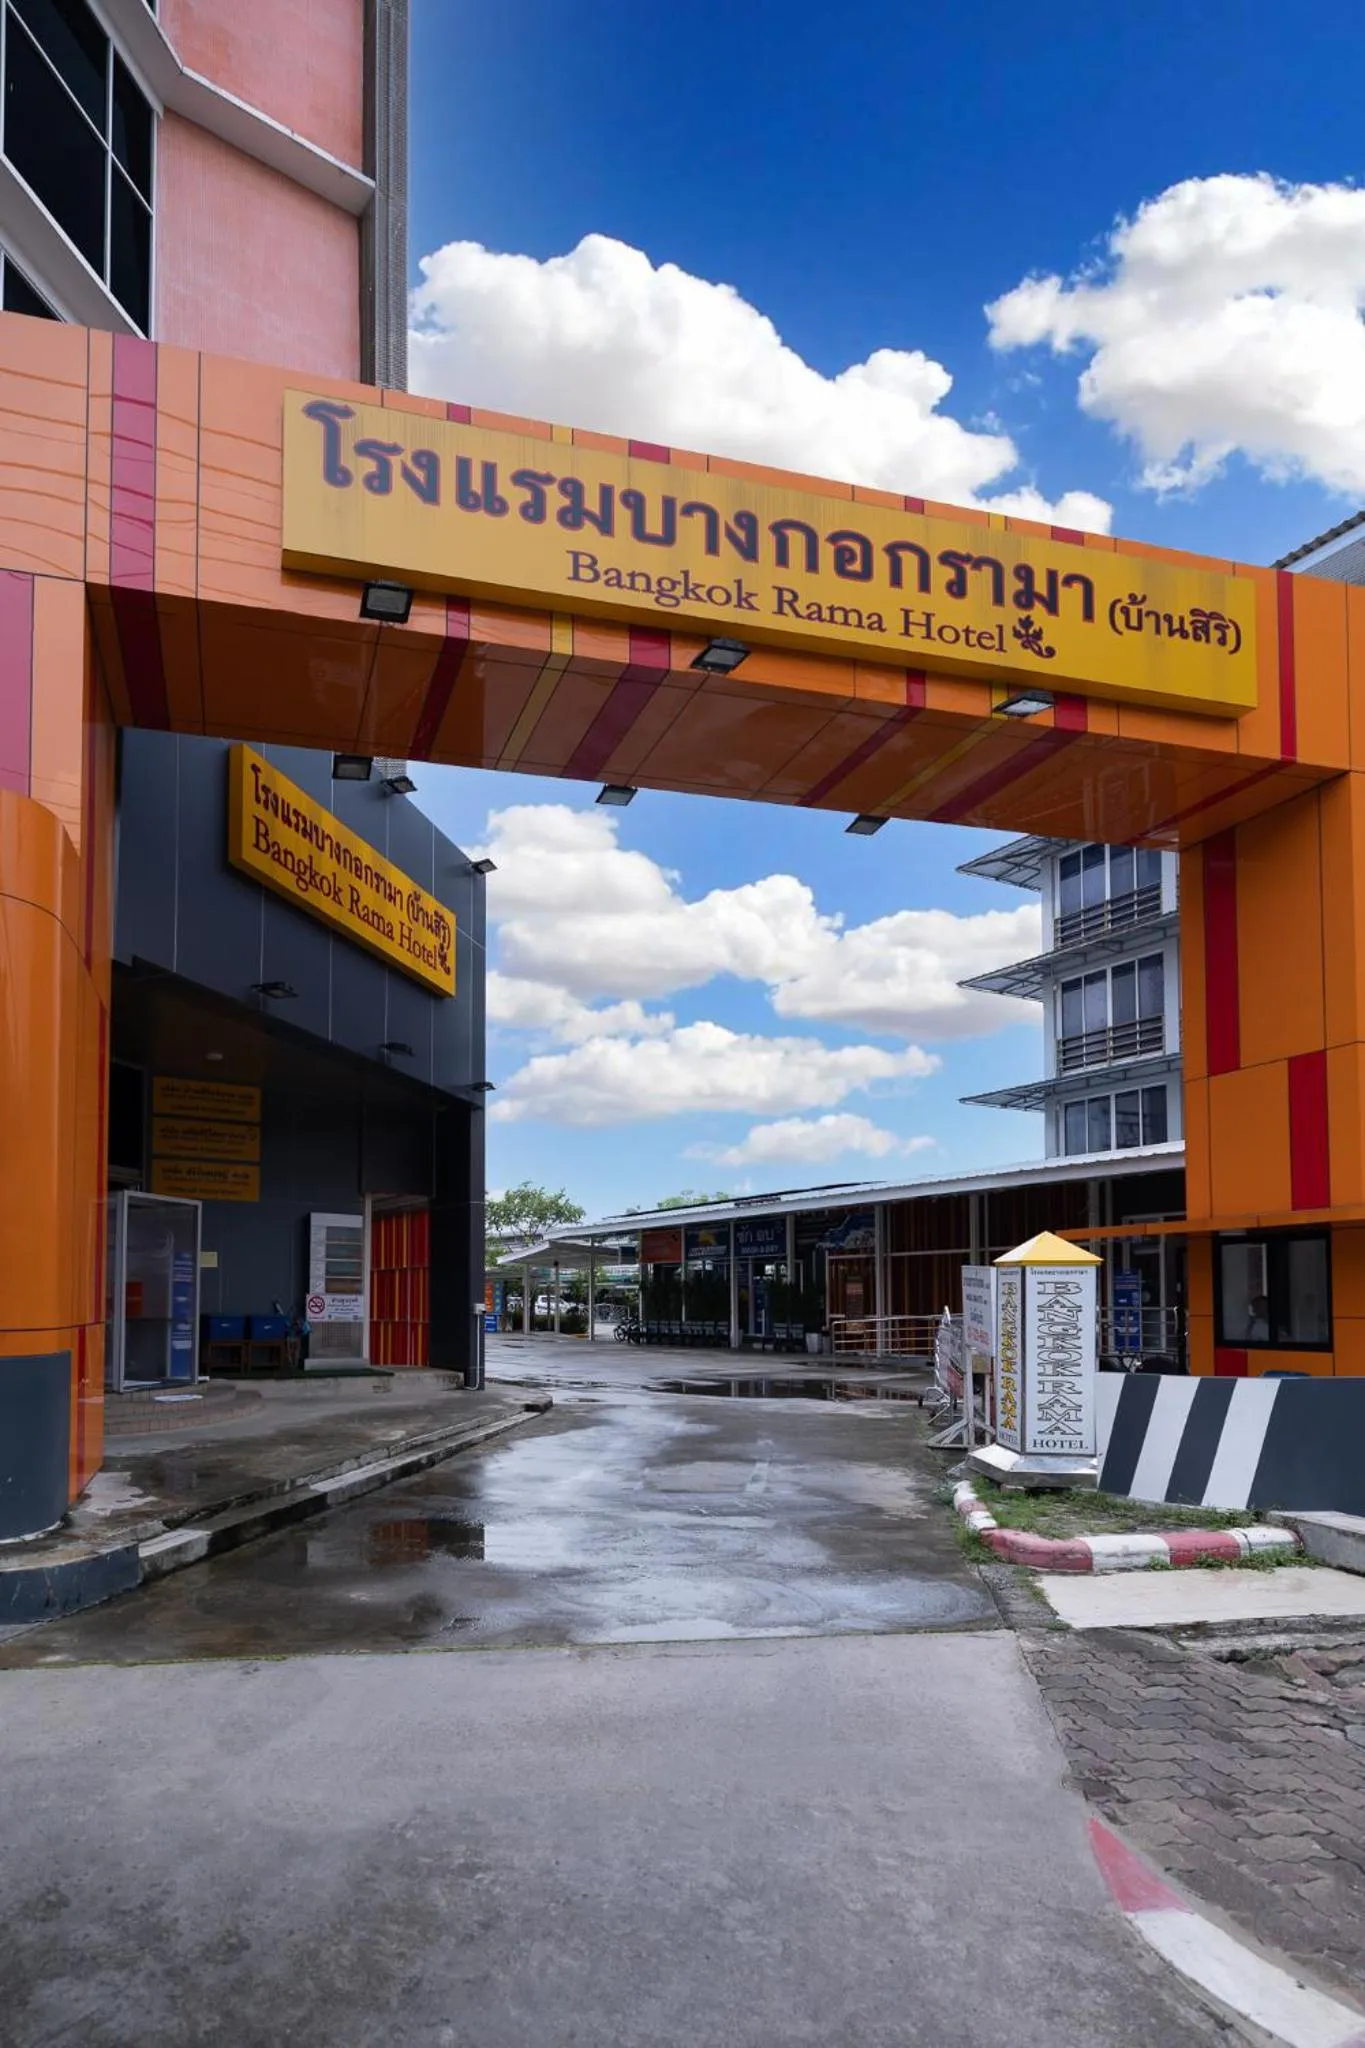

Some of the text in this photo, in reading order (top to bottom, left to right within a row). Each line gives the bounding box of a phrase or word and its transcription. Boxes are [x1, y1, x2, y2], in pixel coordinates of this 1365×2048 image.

[302, 399, 1242, 656] โรงแรมบางกอกรามา (บ้านสิริ)
[566, 549, 1008, 654] Bangkok Rama Hotel
[250, 763, 404, 911] โรงแรมบางกอกรามา
[252, 815, 438, 971] Bangkok Rama Hotel
[1036, 1281, 1083, 1377] BANGKOK
[1031, 1438, 1089, 1450] HOTEL
[1036, 1380, 1083, 1436] RAMA
